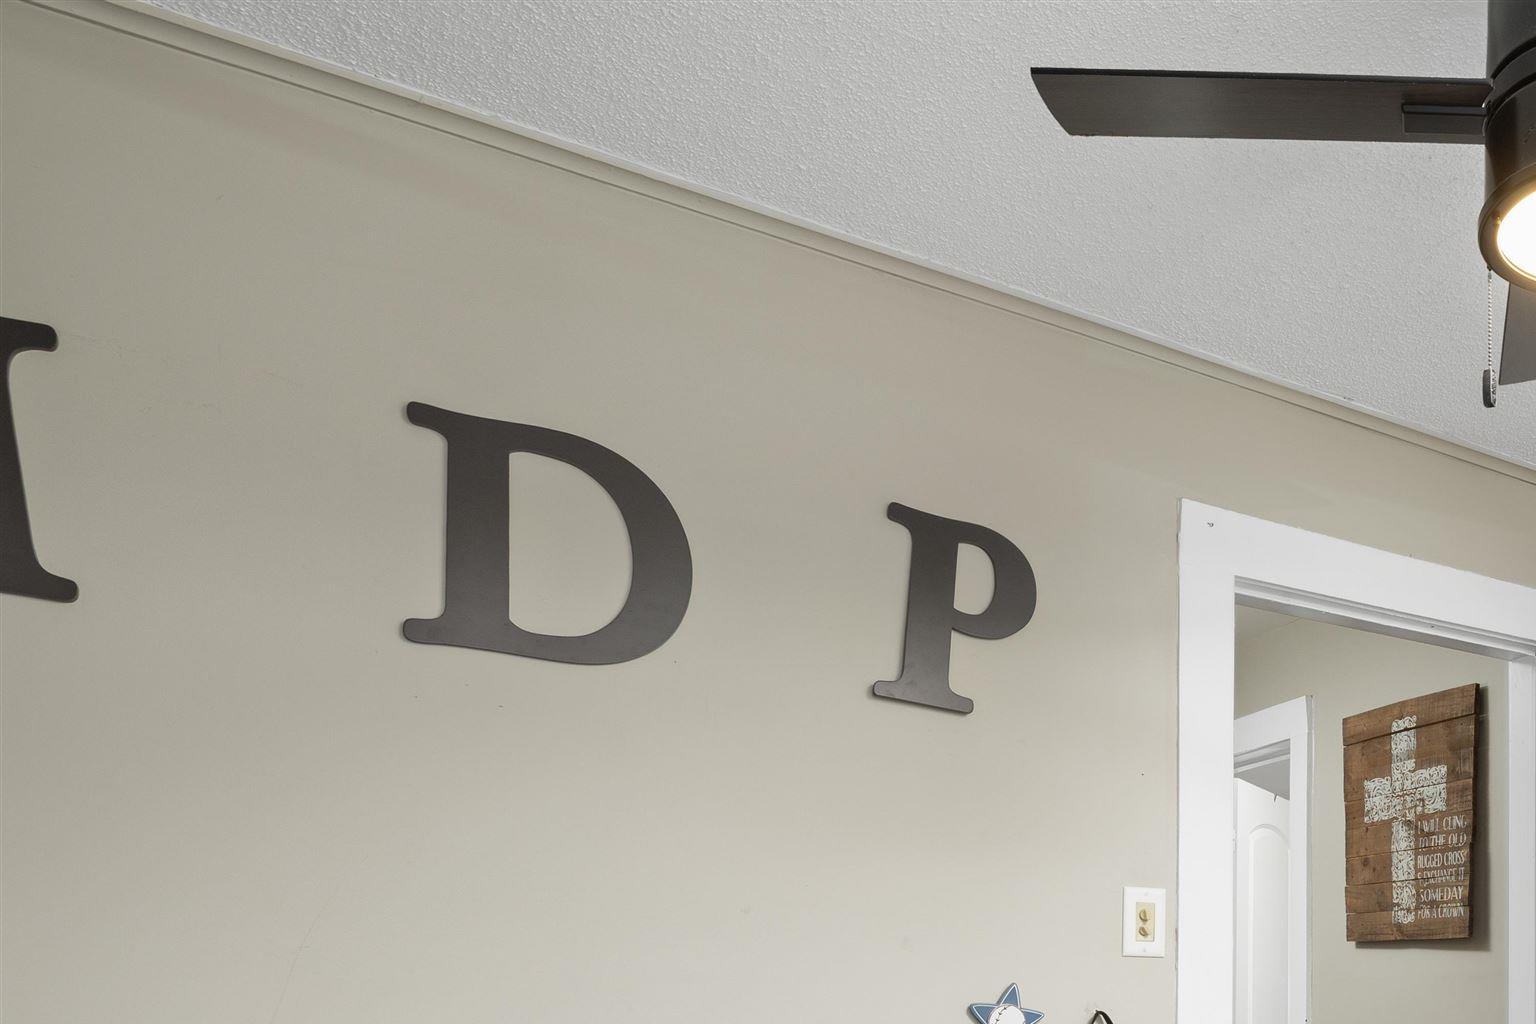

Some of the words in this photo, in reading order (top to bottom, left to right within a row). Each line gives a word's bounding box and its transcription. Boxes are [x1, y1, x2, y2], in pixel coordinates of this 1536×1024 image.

[402, 400, 694, 667] D
[872, 501, 1038, 715] P
[1422, 818, 1440, 832] WILL
[1443, 815, 1467, 830] CLING
[1430, 834, 1446, 850] THE
[1448, 832, 1467, 848] OLD
[1417, 853, 1442, 869] RUGGED
[1444, 850, 1465, 866] CROSS
[1423, 867, 1457, 886] EXCHANGE
[1459, 866, 1465, 881] IT
[1420, 885, 1464, 902] SOMEDAY
[1438, 902, 1464, 919] CROWN
